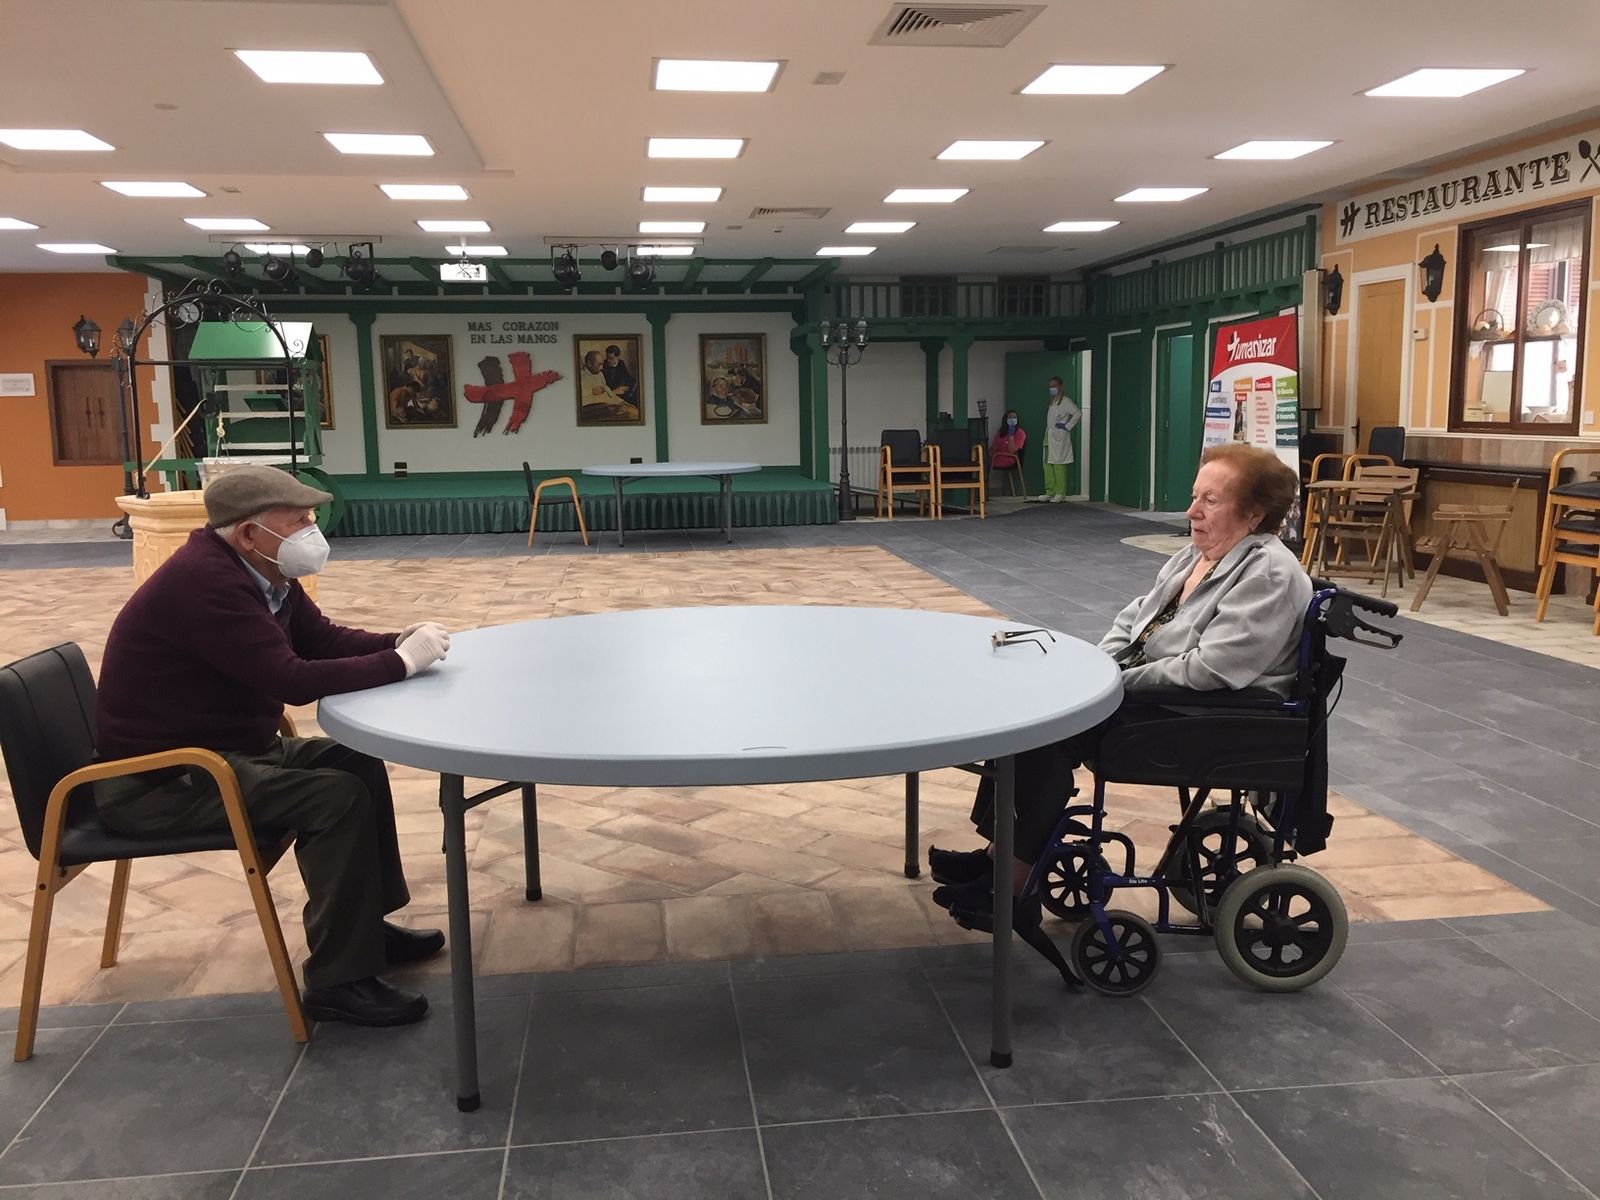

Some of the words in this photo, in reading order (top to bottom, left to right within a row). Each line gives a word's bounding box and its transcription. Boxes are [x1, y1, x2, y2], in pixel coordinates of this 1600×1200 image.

[1364, 151, 1571, 229] RESTAURANTE
[467, 321, 492, 332] MAS
[502, 321, 559, 332] CORAZON
[470, 334, 486, 344] EN
[490, 334, 513, 344] LAS
[517, 334, 557, 344] MANOS
